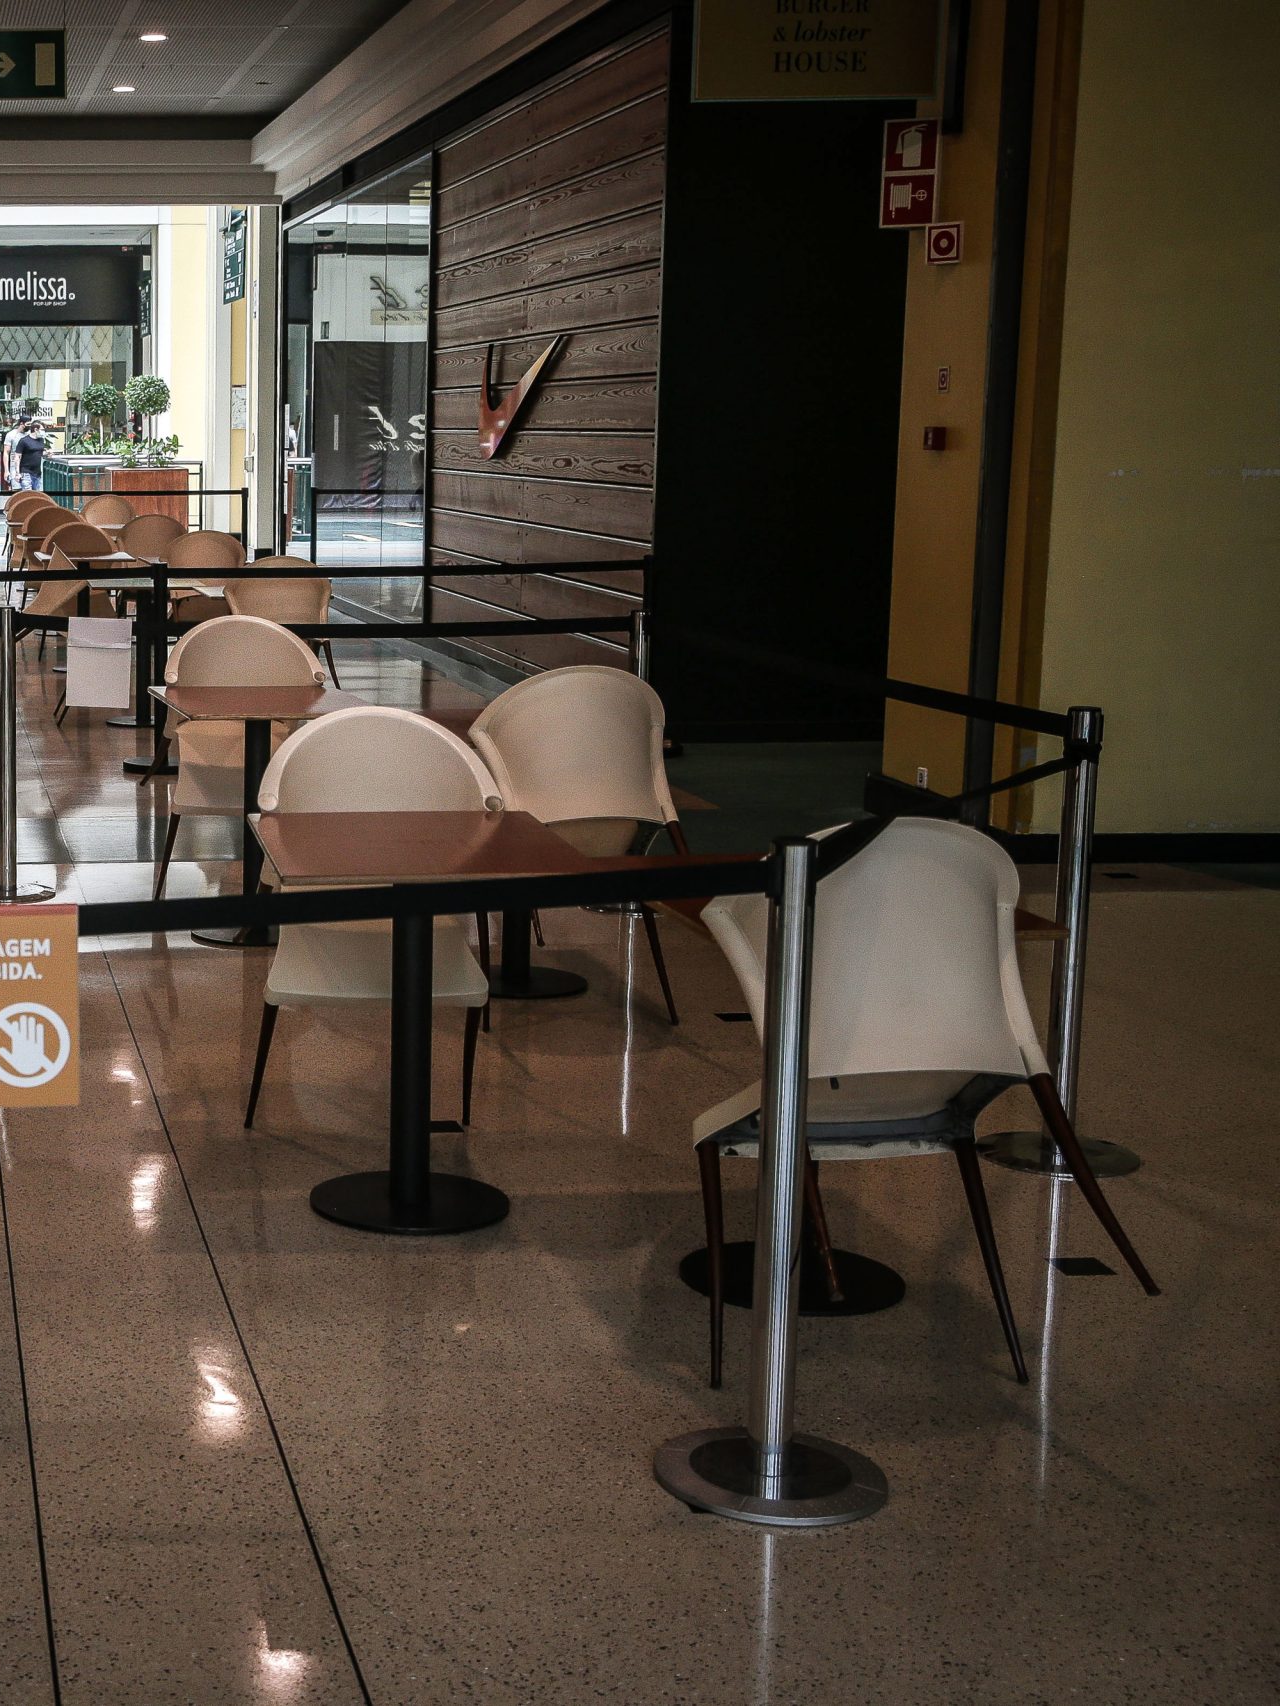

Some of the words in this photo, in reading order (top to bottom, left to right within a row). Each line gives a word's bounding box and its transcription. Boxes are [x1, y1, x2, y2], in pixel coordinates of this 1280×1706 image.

[775, 0, 871, 14] BURGER
[773, 26, 786, 42] &
[794, 20, 872, 42] lobster
[774, 51, 868, 73] HOUSE
[0, 270, 67, 301] melissa
